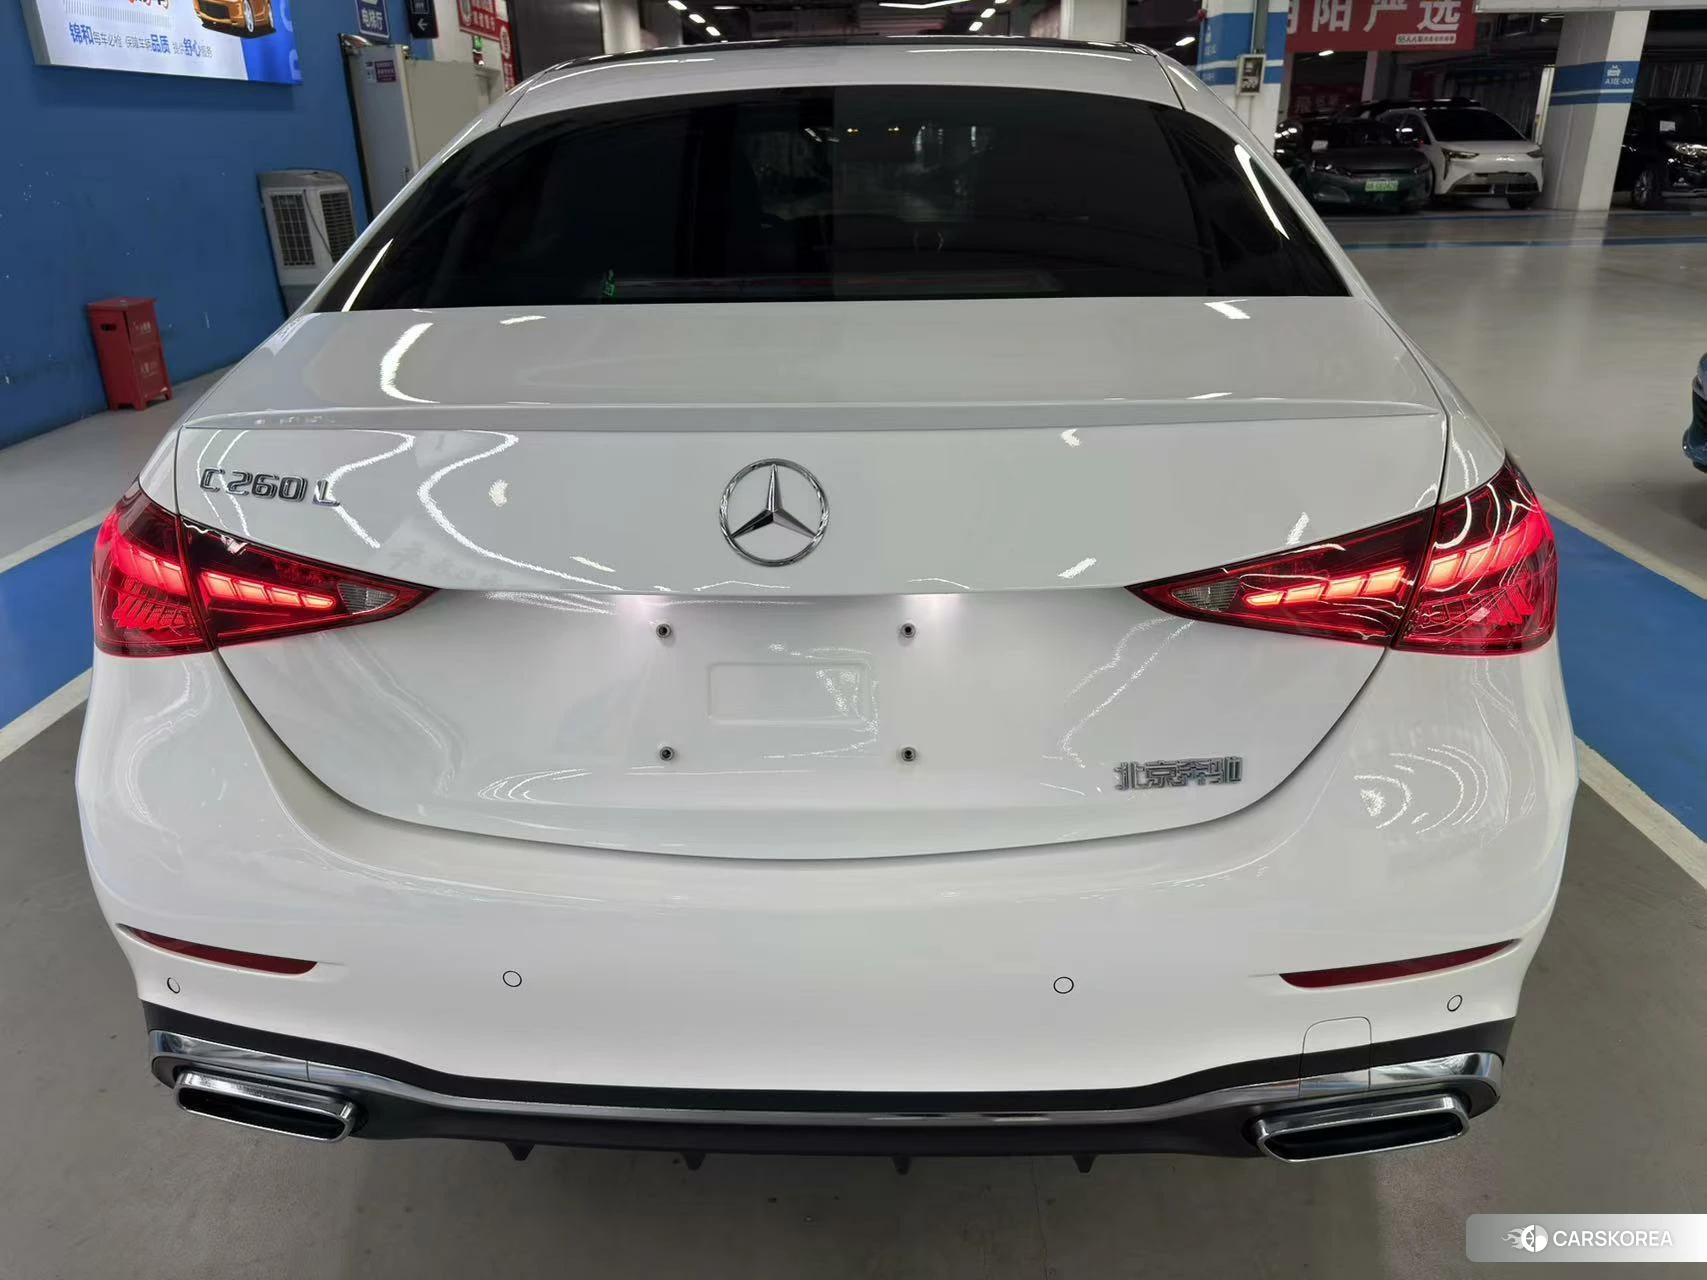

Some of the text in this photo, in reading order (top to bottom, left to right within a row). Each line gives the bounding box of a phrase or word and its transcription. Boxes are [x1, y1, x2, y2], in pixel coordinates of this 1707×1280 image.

[312, 479, 340, 507] L
[1114, 756, 1243, 791] 北京奔驰
